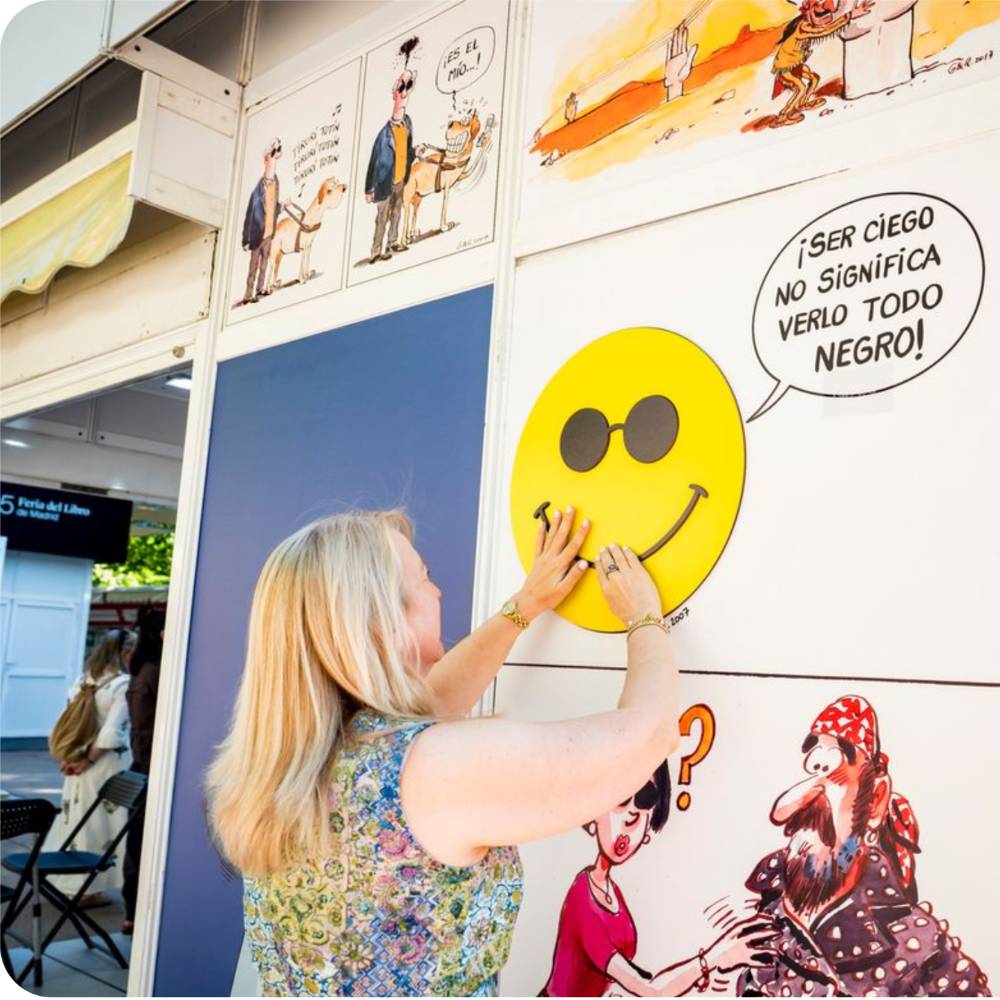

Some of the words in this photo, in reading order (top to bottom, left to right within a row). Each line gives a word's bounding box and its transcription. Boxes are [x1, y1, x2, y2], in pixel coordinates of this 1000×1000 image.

[799, 225, 856, 269] ¡SER
[775, 280, 806, 308] NO
[778, 304, 848, 342] VERLO
[862, 283, 943, 322] TODO
[815, 318, 924, 373] NEGRO!
[18, 496, 45, 511] Feria
